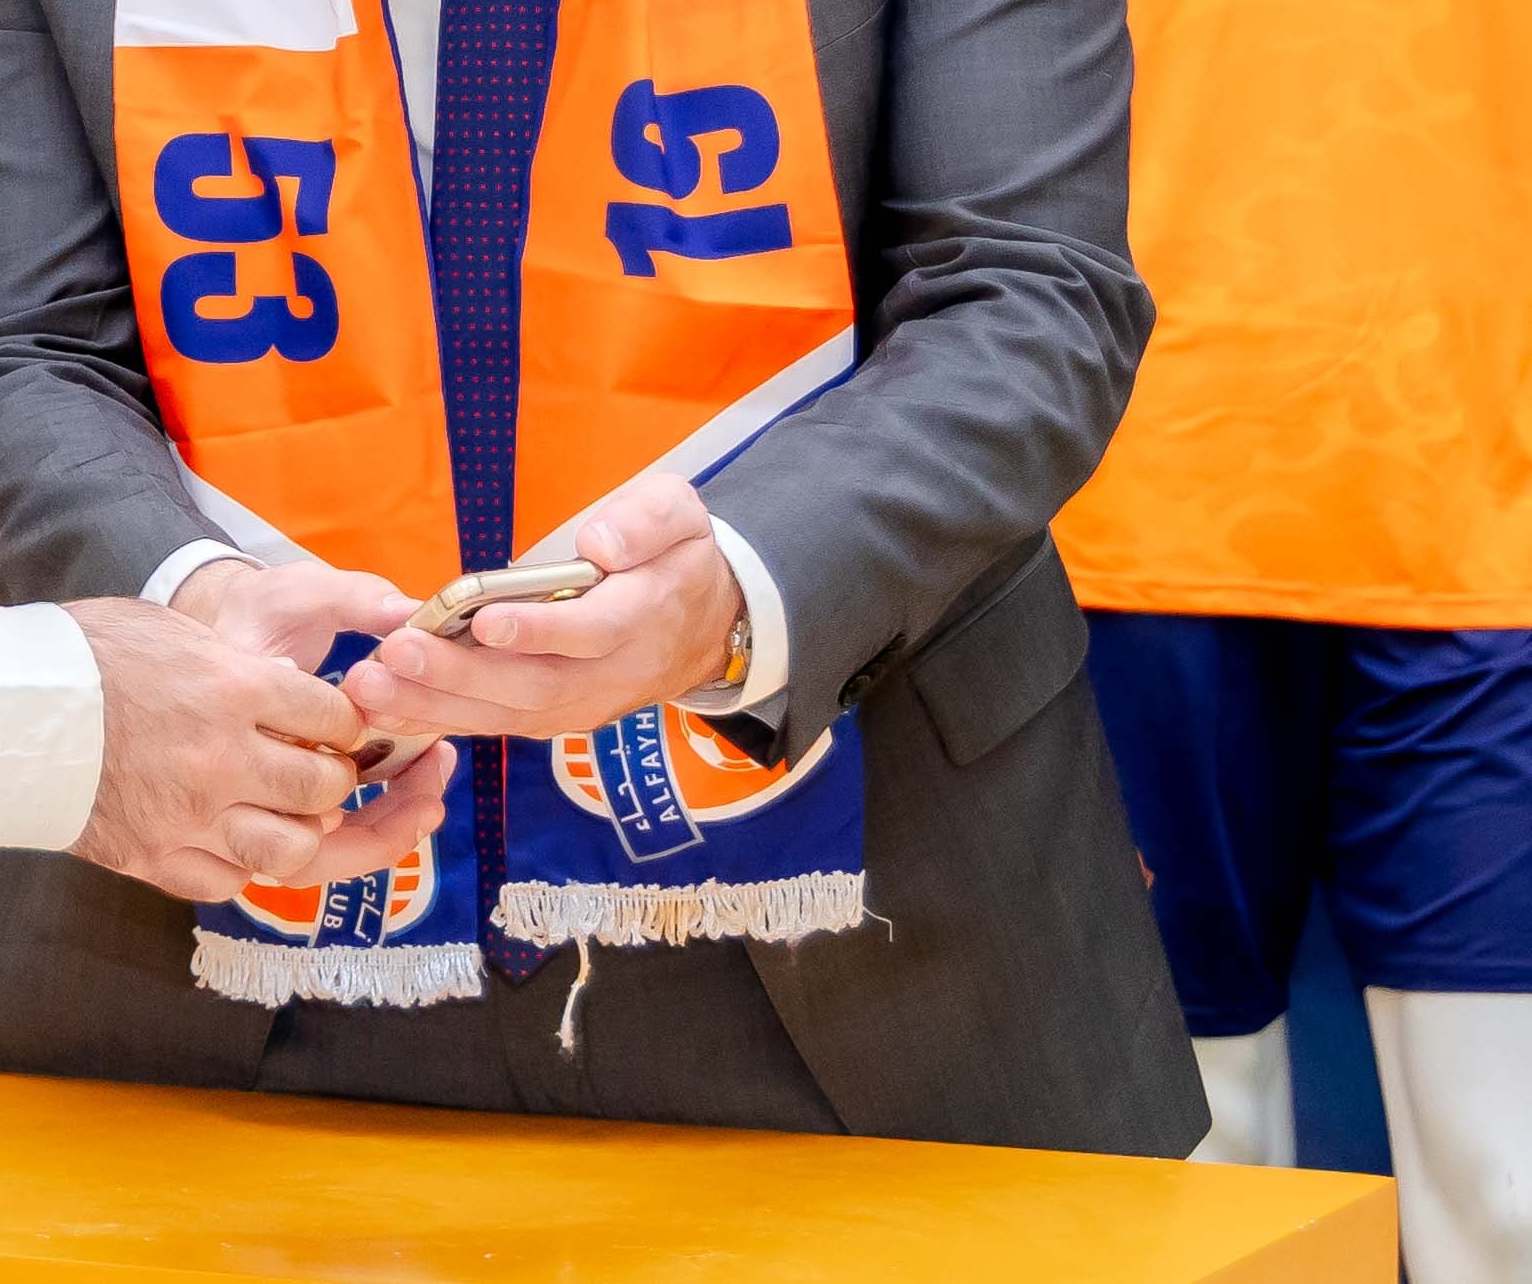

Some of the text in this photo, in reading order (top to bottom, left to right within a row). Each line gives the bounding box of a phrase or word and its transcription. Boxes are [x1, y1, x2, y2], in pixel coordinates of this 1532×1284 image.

[152, 132, 340, 364] 53
[605, 79, 794, 278] 19
[635, 711, 681, 823] ALFAYH
[323, 879, 352, 929] LUB
